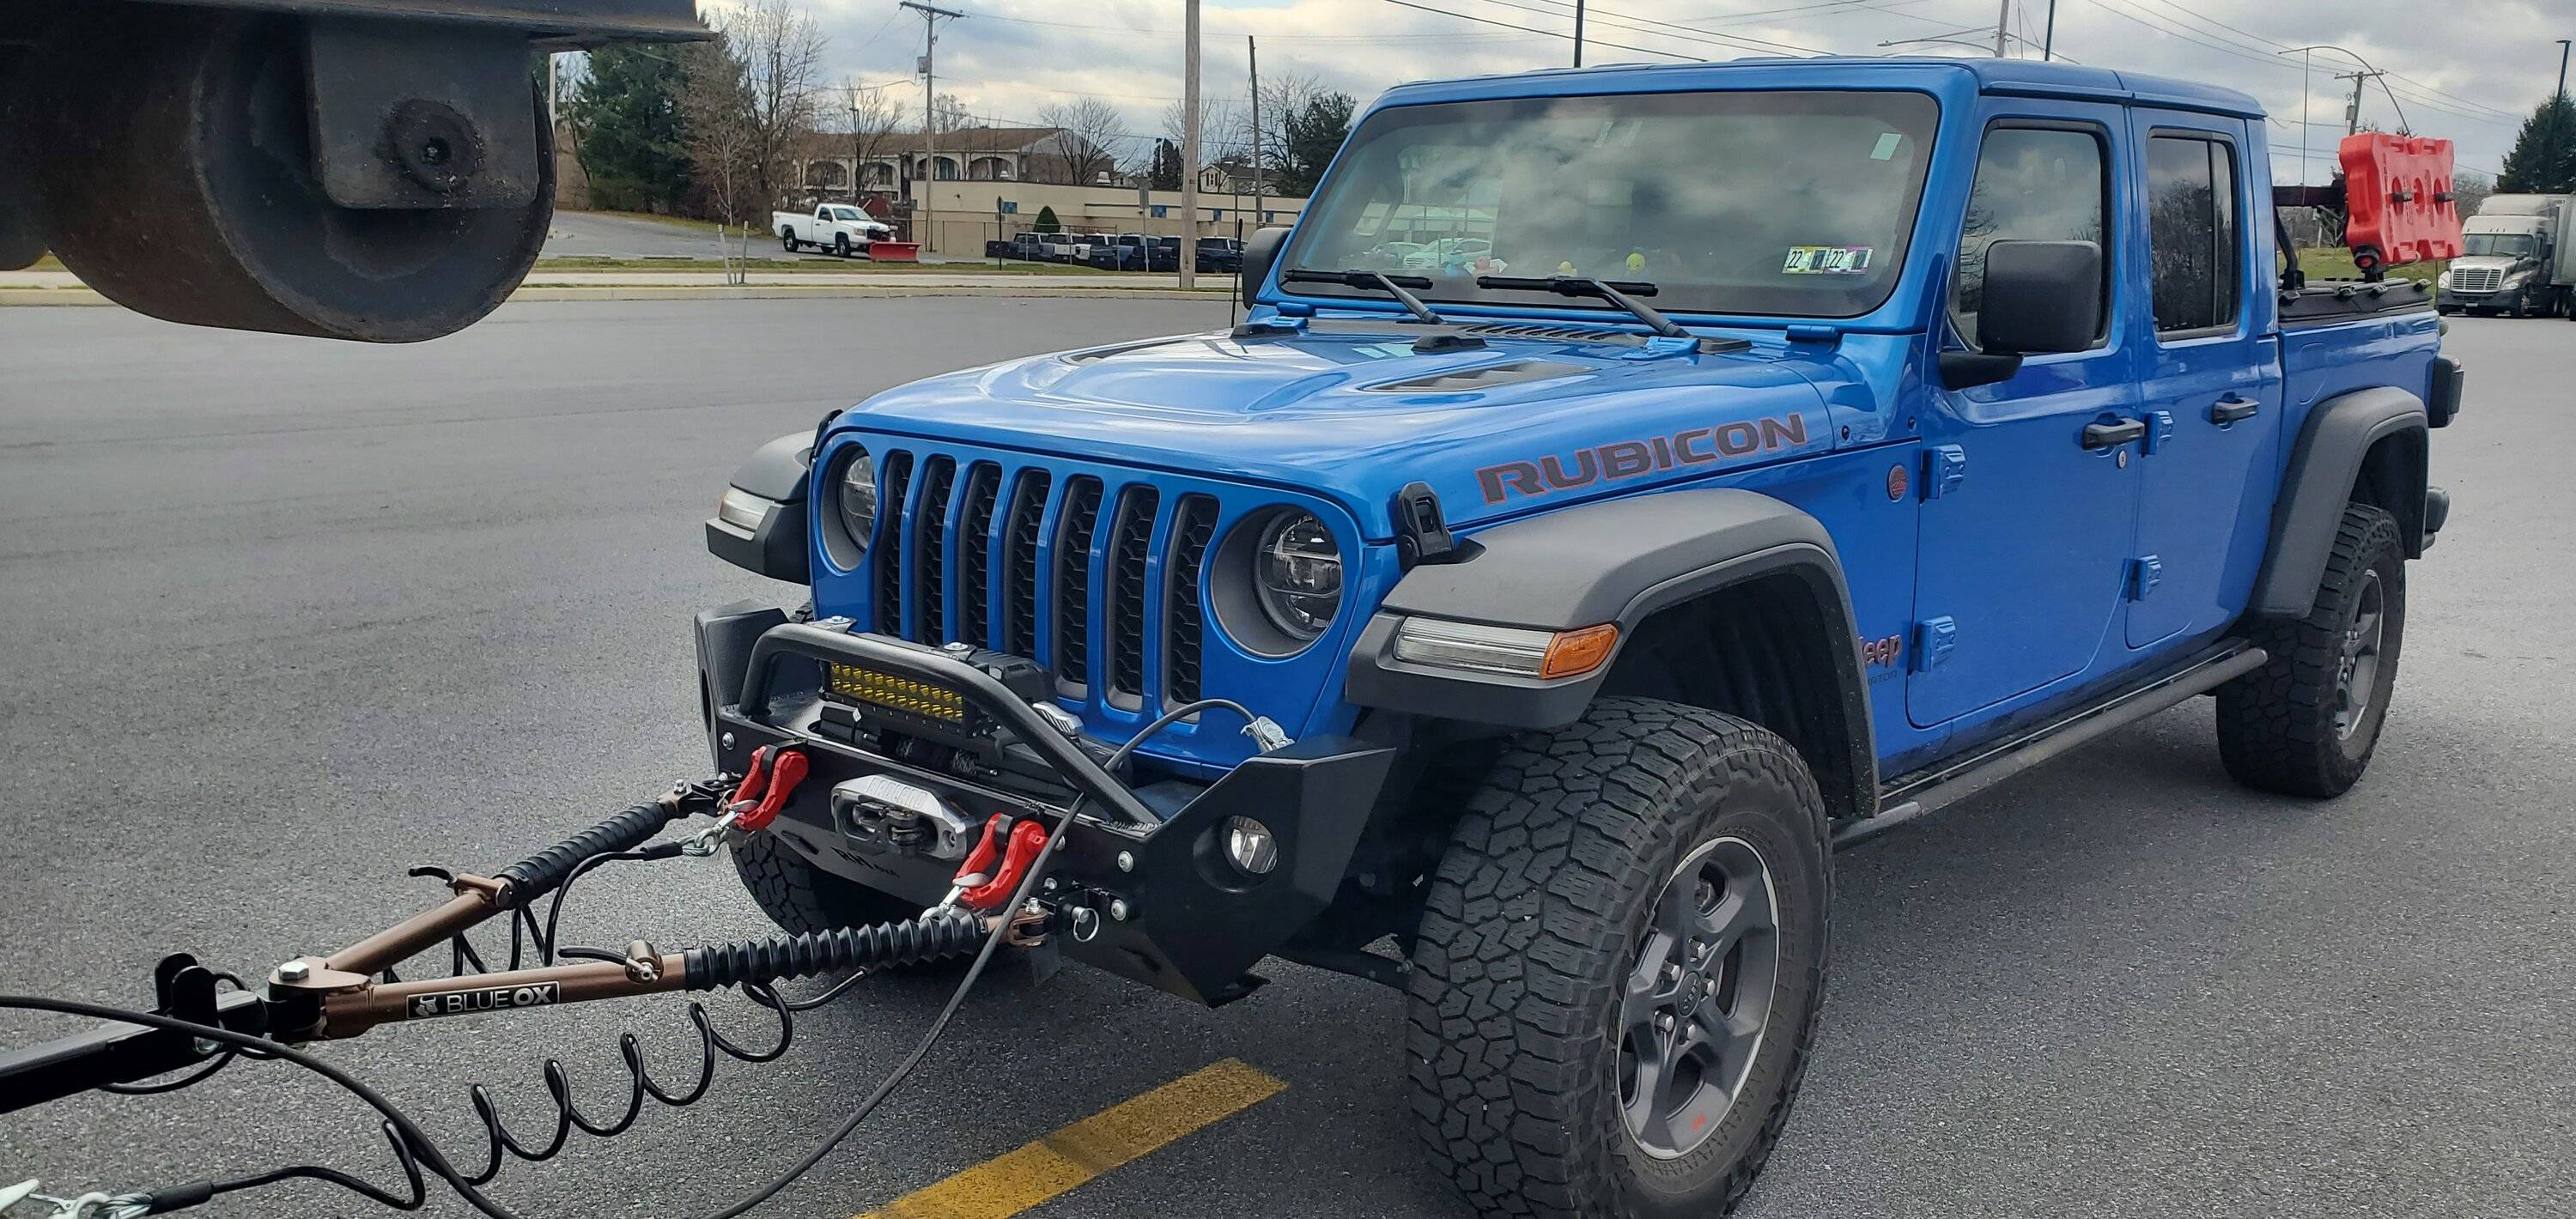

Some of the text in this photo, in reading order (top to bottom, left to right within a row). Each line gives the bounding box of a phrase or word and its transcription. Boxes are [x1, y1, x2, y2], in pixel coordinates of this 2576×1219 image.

[1788, 251, 1803, 268] 22
[1829, 251, 1844, 269] 22
[1475, 412, 1807, 505] RUBICON
[1858, 634, 1901, 668] eep
[447, 986, 552, 1013] BLUE OX
